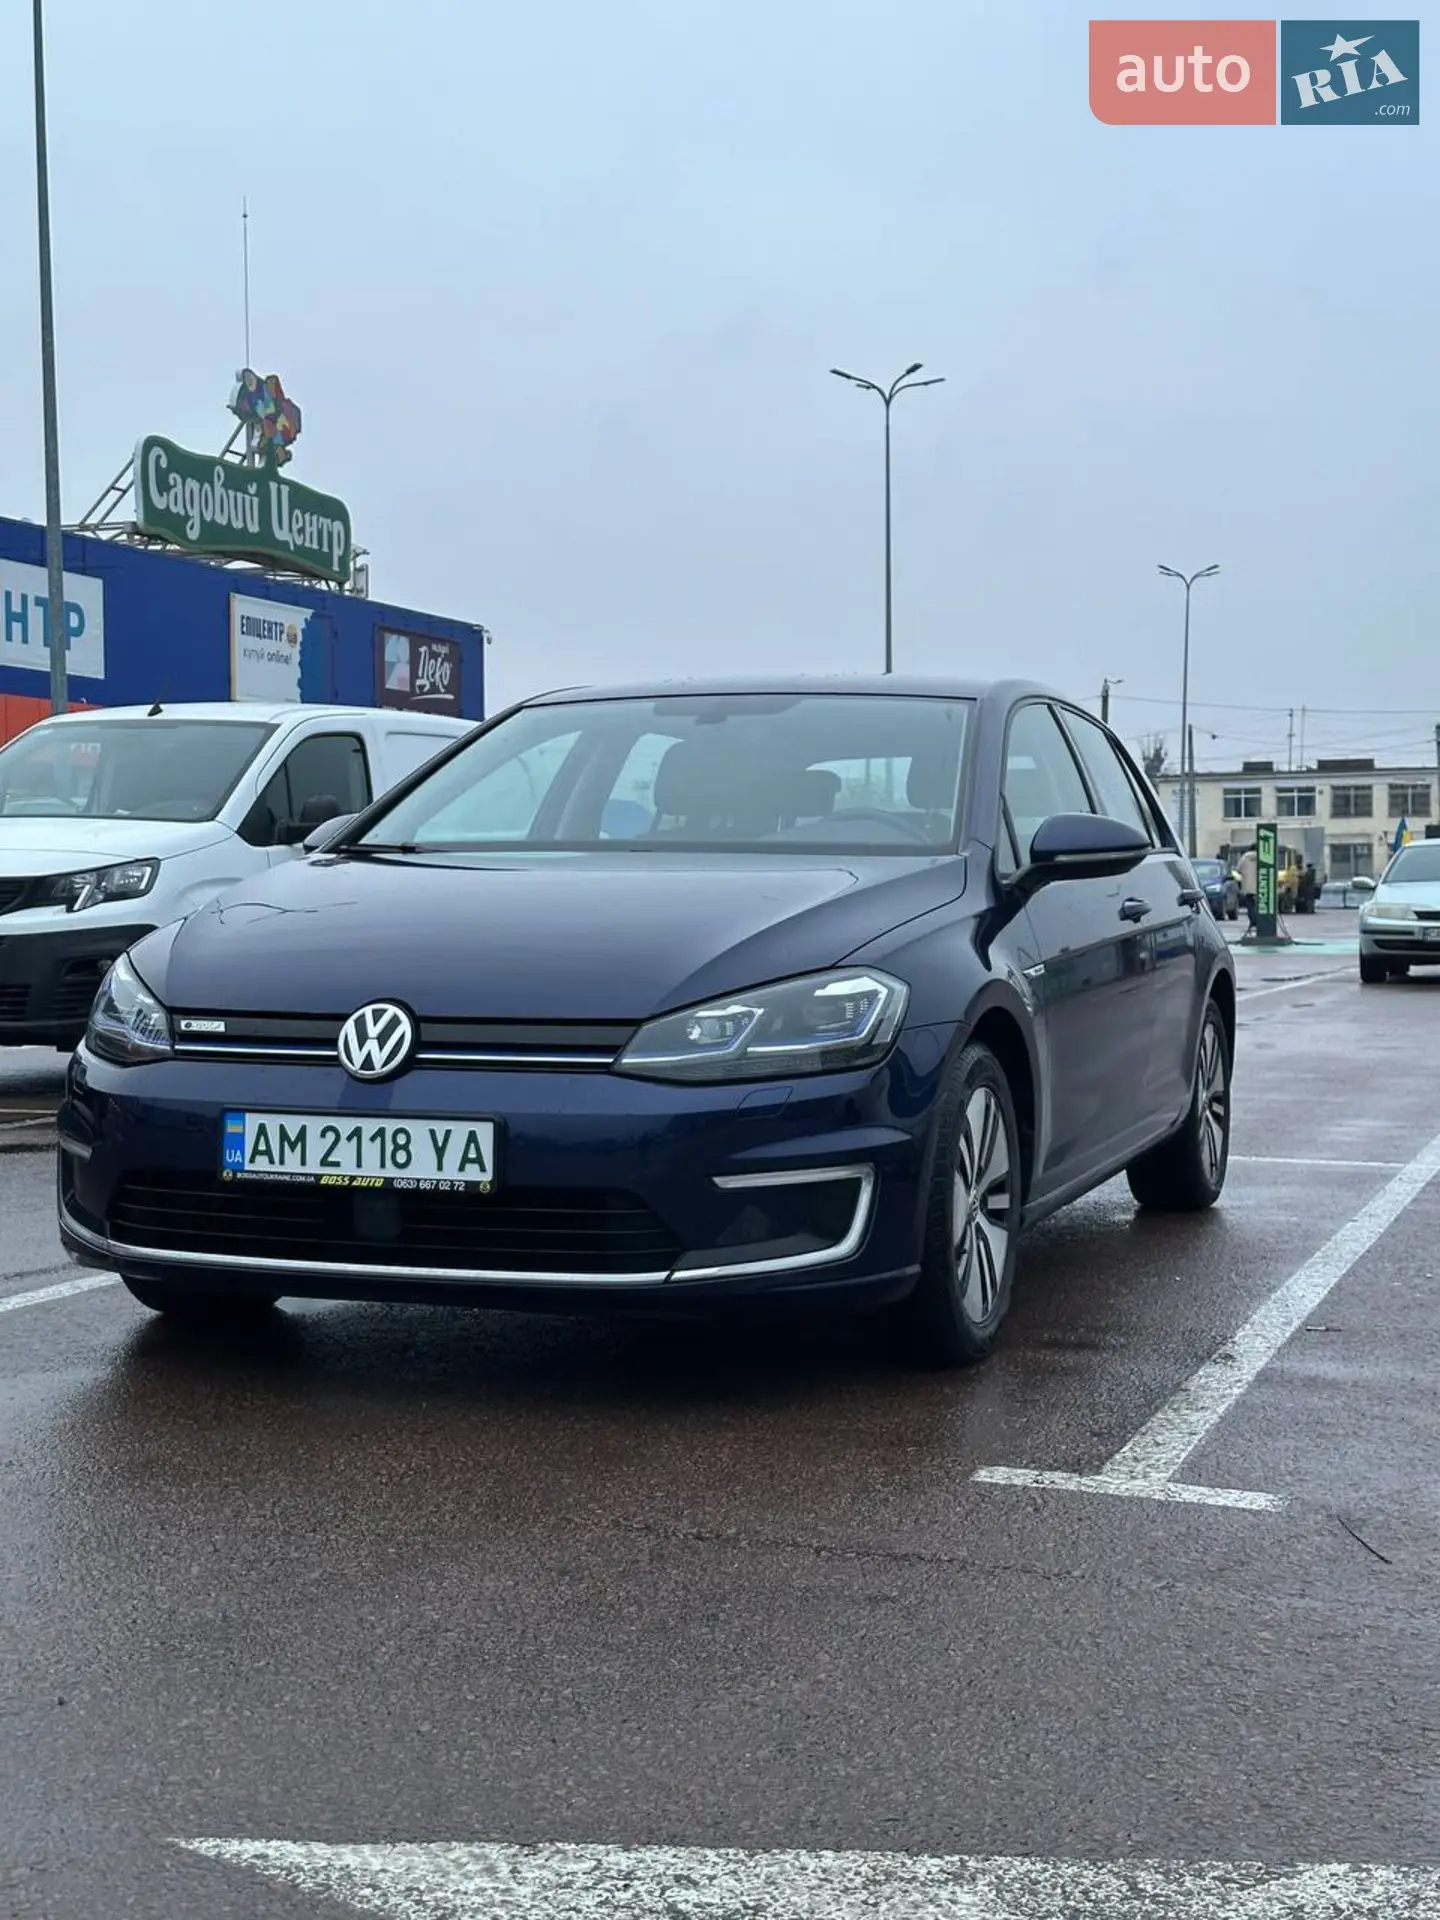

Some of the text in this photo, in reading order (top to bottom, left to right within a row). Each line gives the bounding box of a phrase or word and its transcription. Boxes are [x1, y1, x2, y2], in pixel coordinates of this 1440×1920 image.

[148, 446, 345, 572] Садовий Центр
[240, 614, 285, 642] ЕПІЦЕНТР
[415, 645, 451, 694] Деко
[225, 1149, 243, 1163] UA
[248, 1122, 487, 1173] AM 2118 YA
[319, 1175, 385, 1188] BOSS AUTO
[393, 1178, 417, 1190] (063)
[439, 1180, 451, 1191] 02
[453, 1181, 466, 1191] 72
